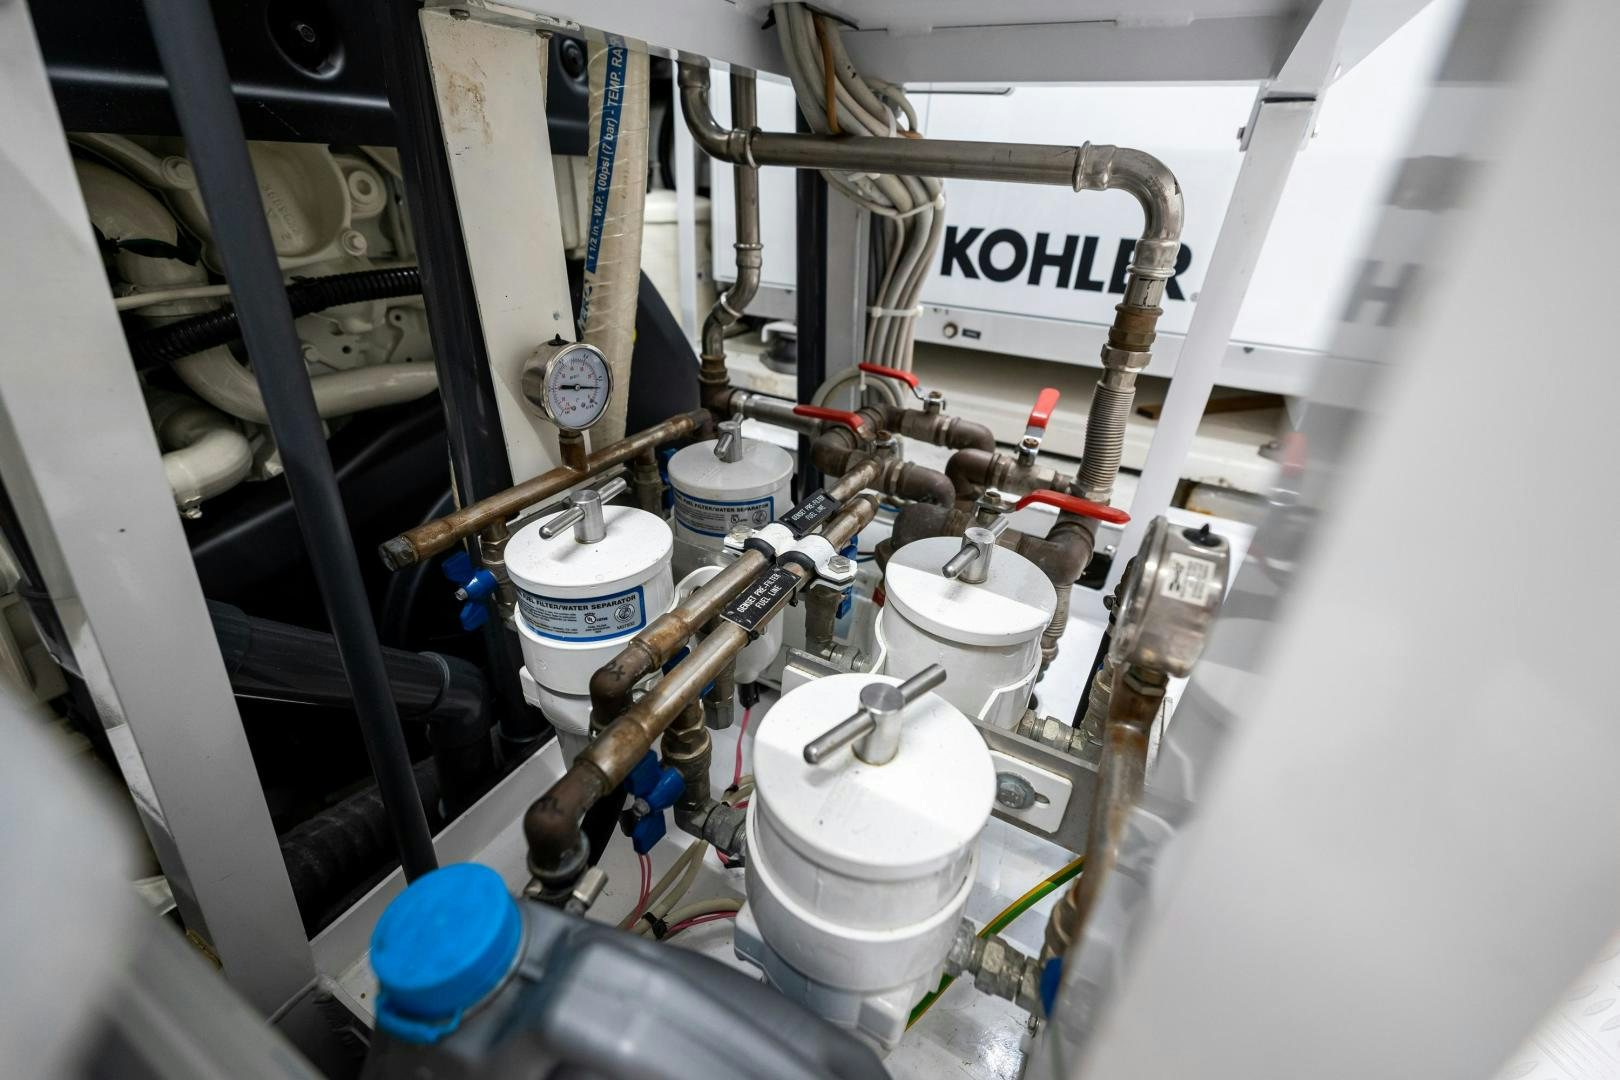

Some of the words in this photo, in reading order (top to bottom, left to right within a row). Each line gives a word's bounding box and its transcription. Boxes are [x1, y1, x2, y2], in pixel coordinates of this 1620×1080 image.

[607, 71, 621, 107] TEMP.
[605, 117, 618, 142] bar)
[602, 143, 613, 155] (7
[597, 157, 610, 192] 100psi
[594, 194, 605, 217] W.P.
[592, 225, 600, 236] in
[588, 238, 598, 253] 1/2
[791, 507, 807, 521] GENSET
[804, 494, 825, 510] PRE-FILTER
[805, 511, 818, 521] FUEL
[815, 504, 827, 514] LINE
[536, 600, 589, 611] FILTER/WATER
[591, 594, 637, 610] SEPARATOR
[736, 595, 757, 613] GENSET
[753, 573, 782, 597] PRE-FILTER
[755, 595, 772, 609] FUEL
[768, 584, 783, 597] LINE
